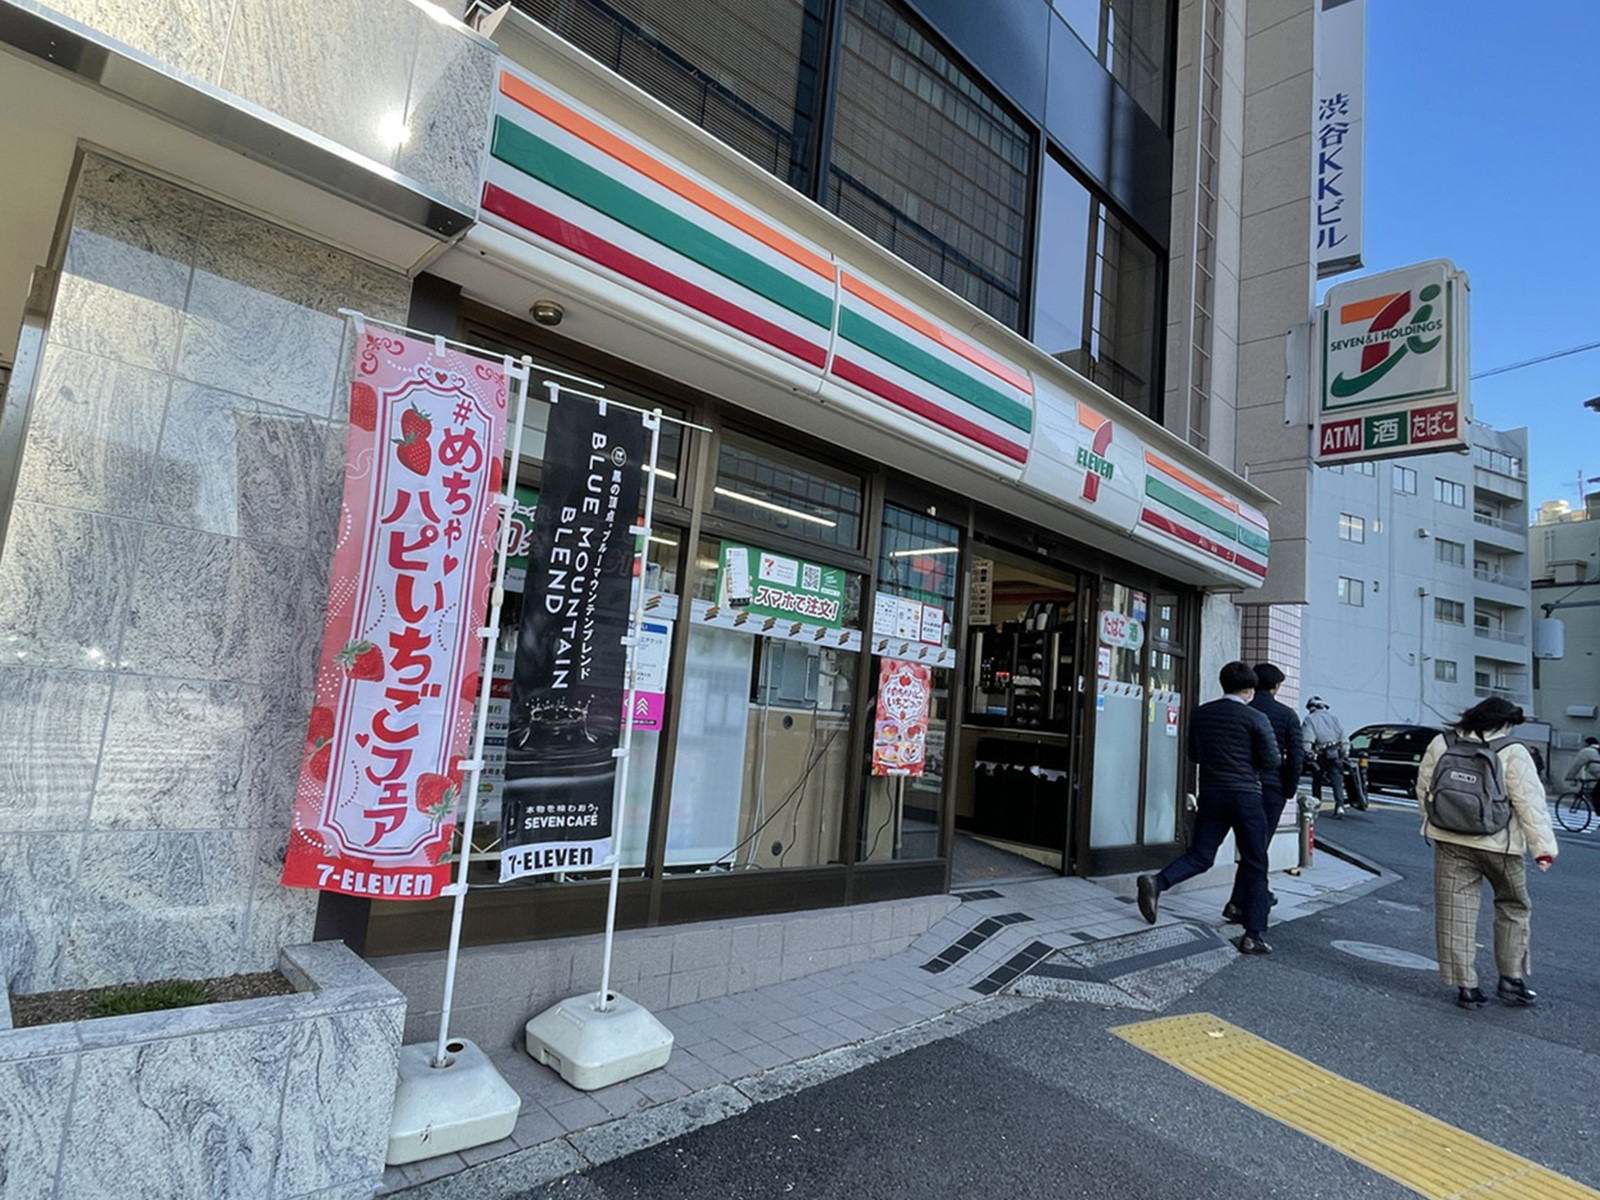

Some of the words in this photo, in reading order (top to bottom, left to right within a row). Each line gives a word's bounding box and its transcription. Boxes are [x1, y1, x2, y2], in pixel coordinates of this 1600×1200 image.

[1316, 92, 1350, 249] 渋谷KKビル
[1381, 318, 1443, 341] HOLDINGS
[1322, 424, 1360, 451] ATM
[1372, 417, 1400, 445] 酒
[1412, 409, 1456, 439] たばこ
[583, 431, 608, 515] BLUE
[545, 505, 577, 614] BLEND
[551, 526, 595, 689] MOUNTAIN
[523, 815, 566, 830] SEVEN
[566, 812, 599, 828] CAFÉ
